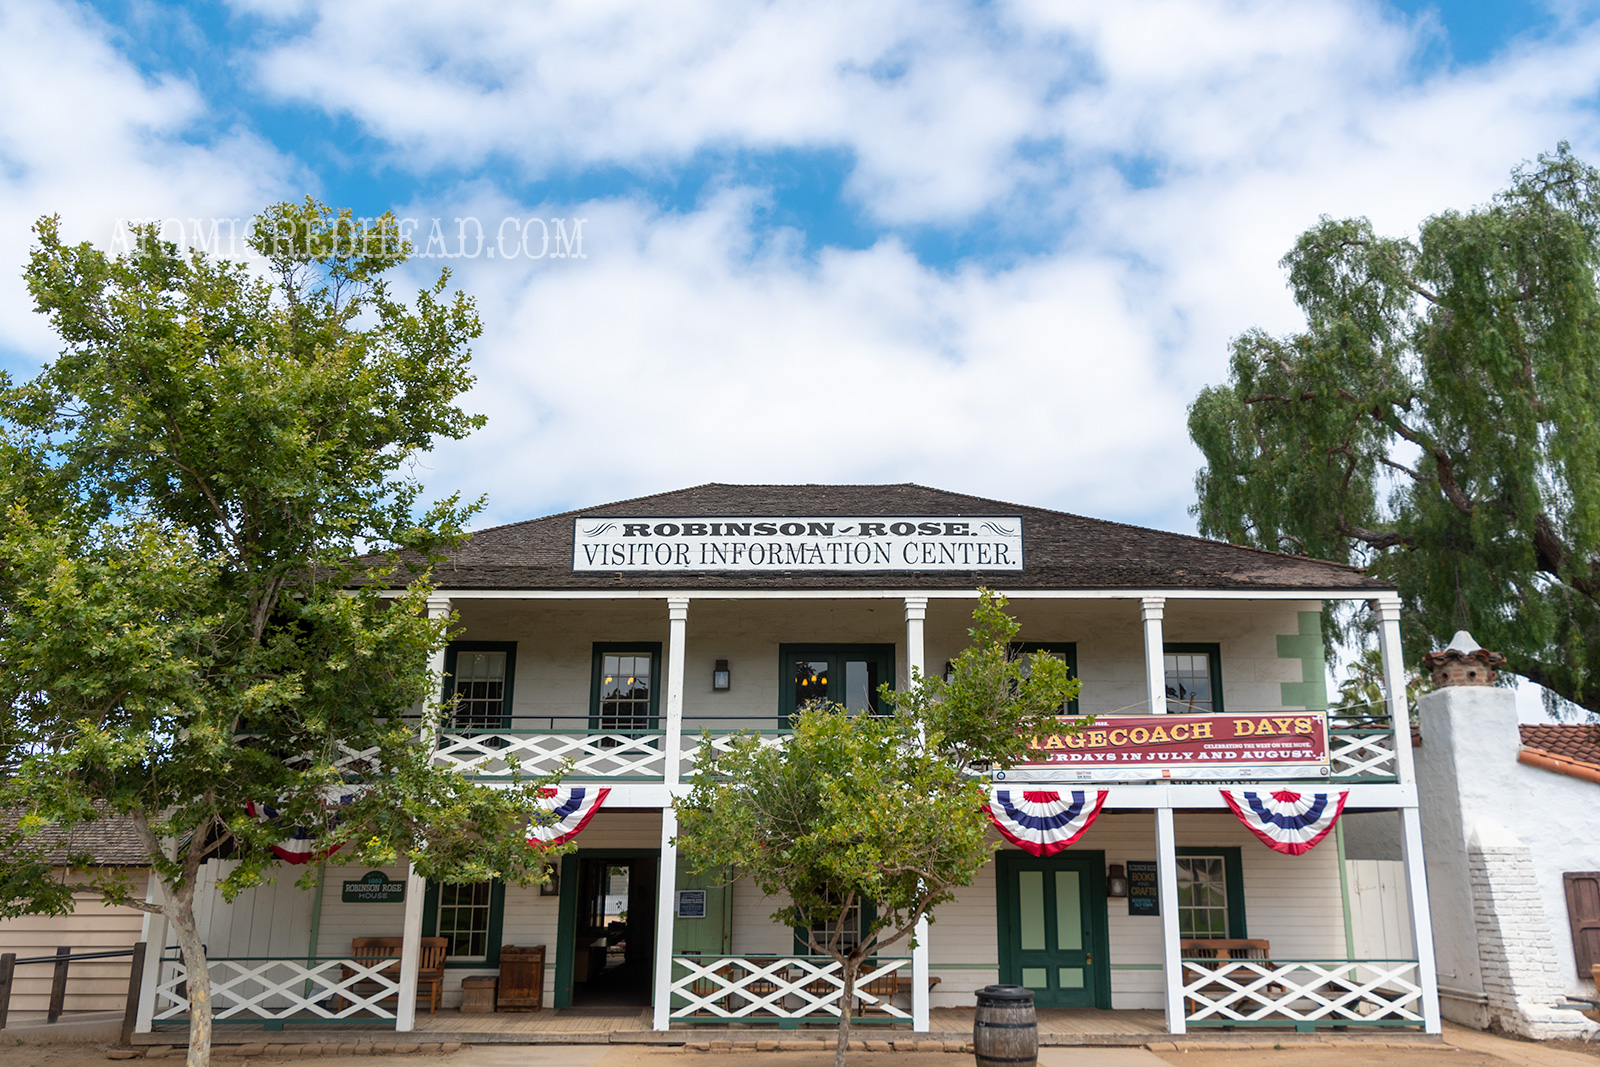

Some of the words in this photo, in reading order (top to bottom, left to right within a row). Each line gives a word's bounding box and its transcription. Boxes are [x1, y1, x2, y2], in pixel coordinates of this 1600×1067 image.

[582, 543, 691, 566] VISITOR
[699, 542, 892, 566] INFORMATION
[902, 541, 1017, 565] CENTER.
[1017, 722, 1214, 750] TAGECOACH
[1121, 752, 1142, 761] IN
[1146, 752, 1194, 761] JULY
[1198, 751, 1238, 760] AND
[1241, 750, 1316, 759] AUGUST.
[1131, 872, 1155, 881] BOOKS
[345, 884, 380, 892] ROBINSON
[382, 884, 402, 892] ROSE
[1131, 887, 1157, 896] CRAFTS
